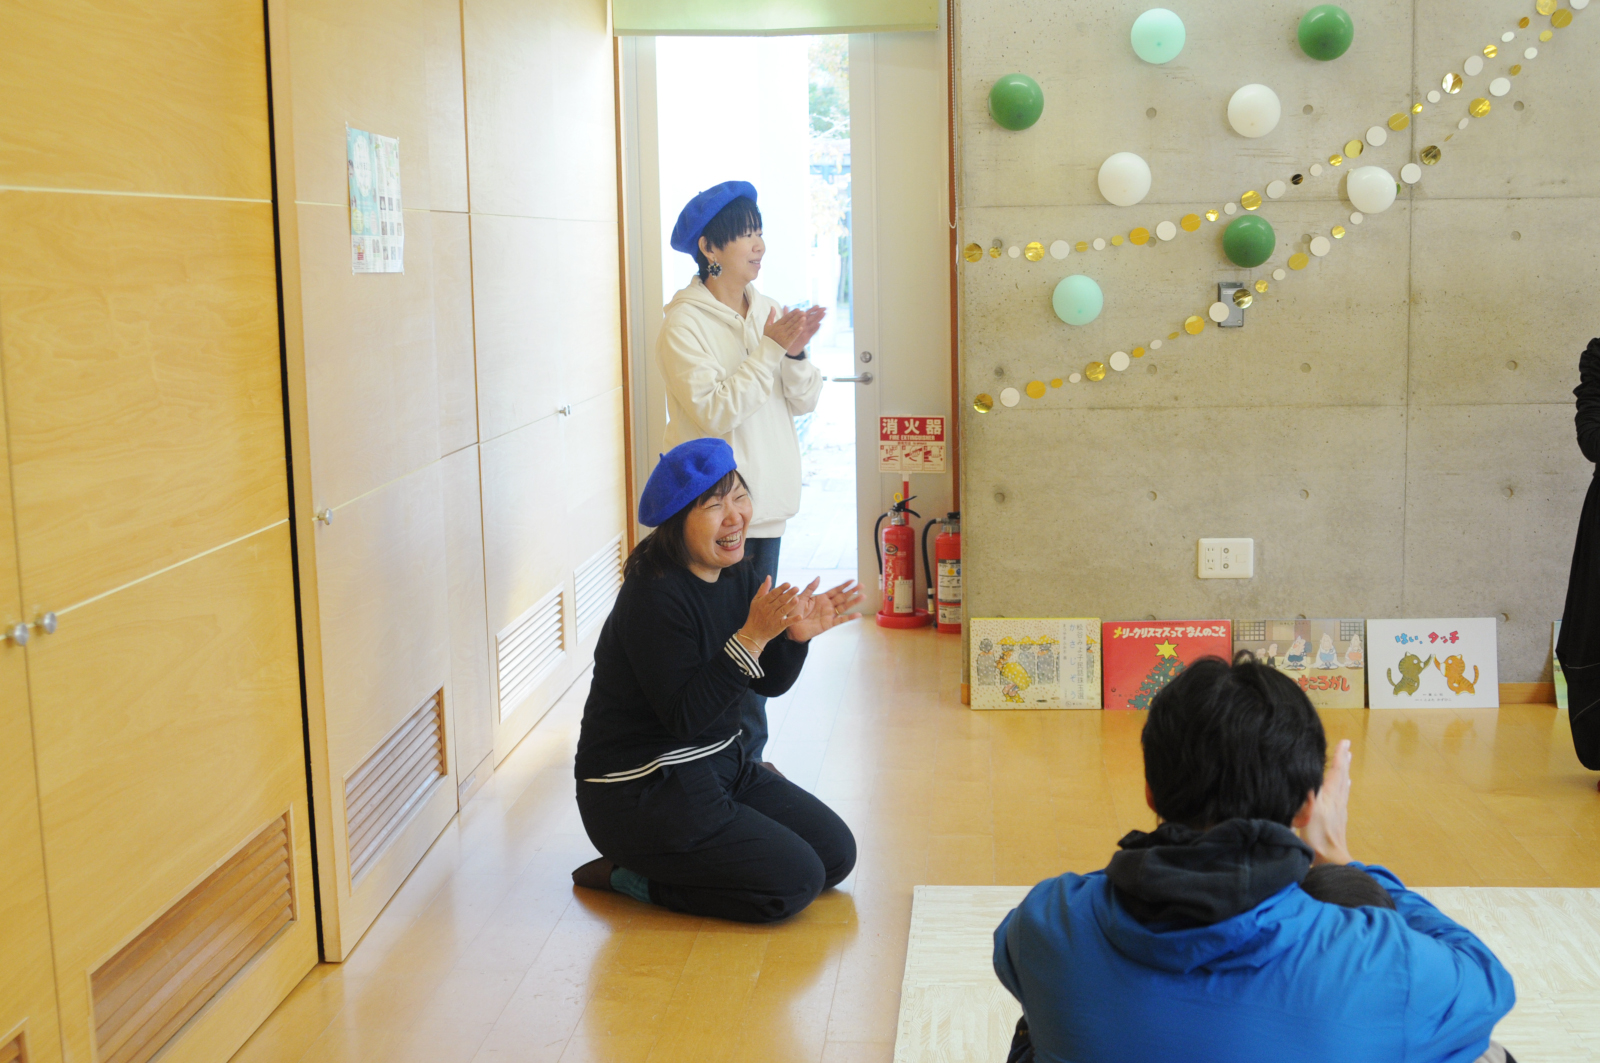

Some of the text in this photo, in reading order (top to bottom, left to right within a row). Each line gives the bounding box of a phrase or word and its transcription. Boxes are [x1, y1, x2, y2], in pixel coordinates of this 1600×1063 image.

[882, 418, 942, 435] 消火器
[1069, 624, 1077, 699] かさじぞう
[1293, 674, 1351, 692] もころがし
